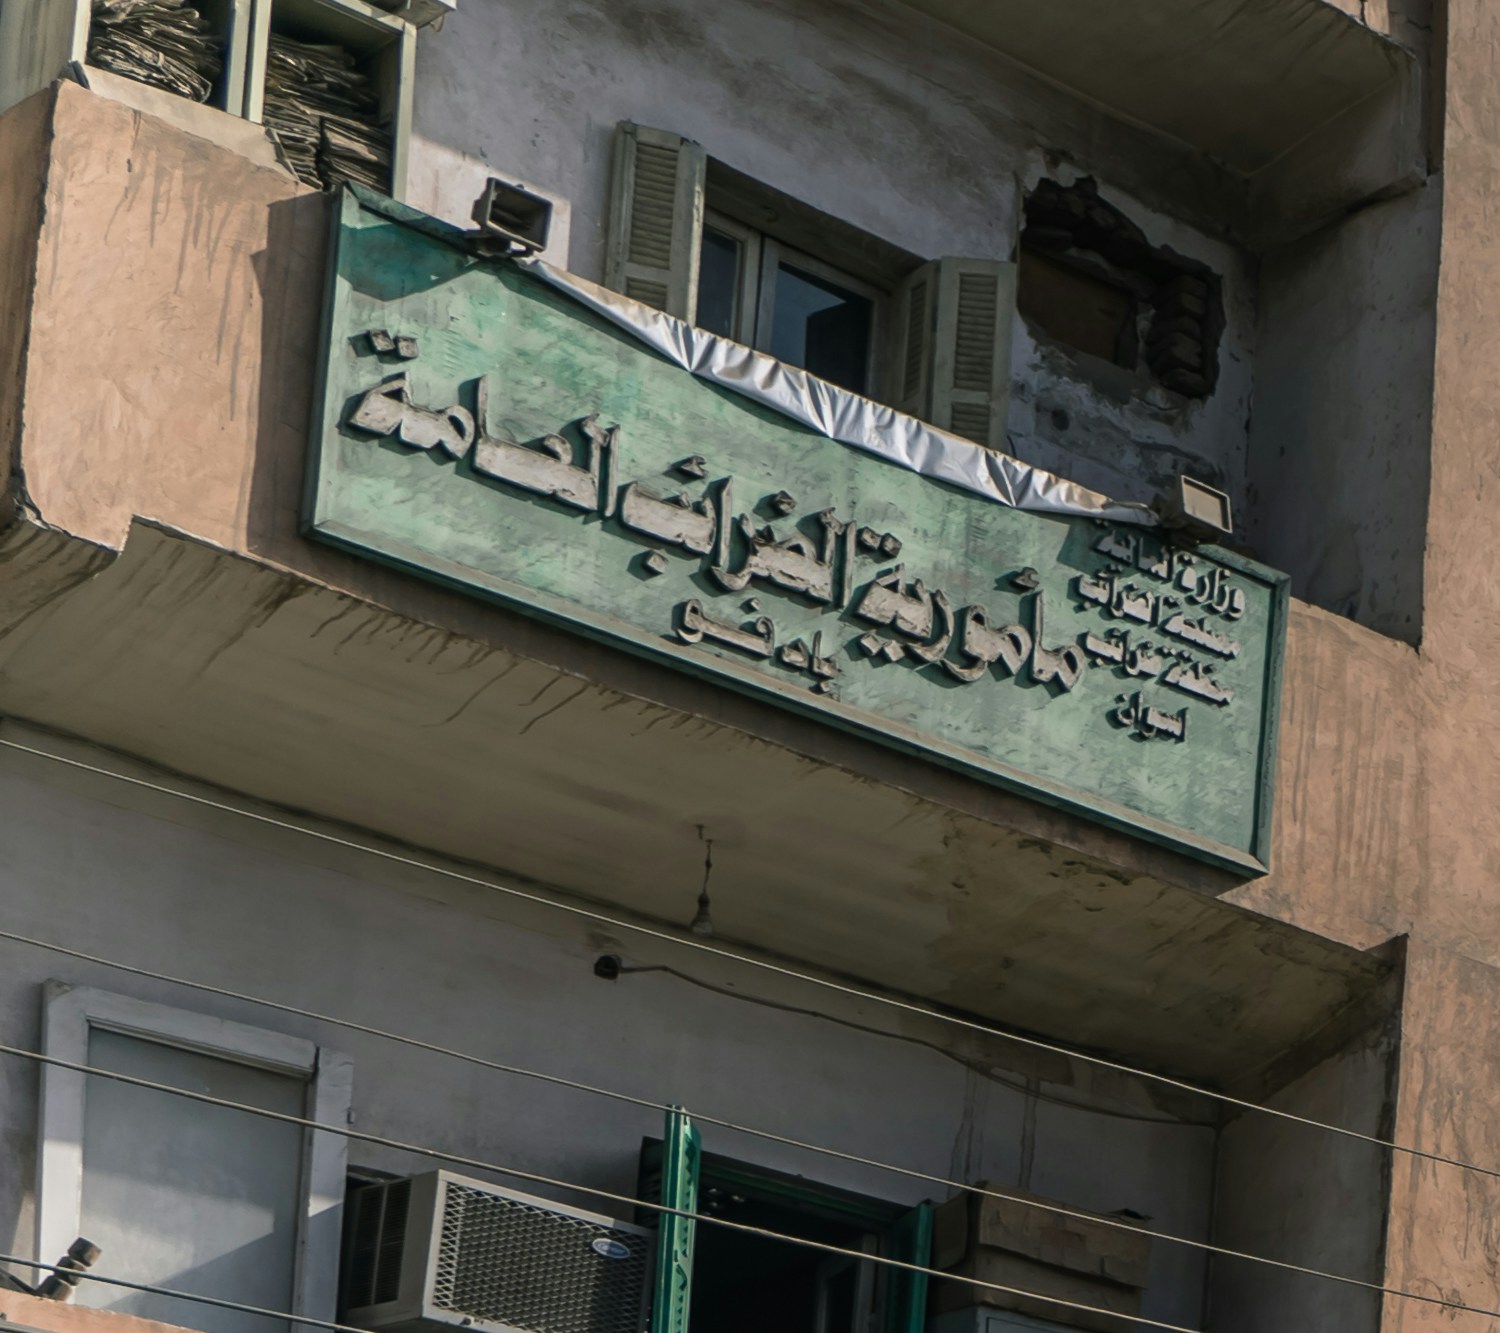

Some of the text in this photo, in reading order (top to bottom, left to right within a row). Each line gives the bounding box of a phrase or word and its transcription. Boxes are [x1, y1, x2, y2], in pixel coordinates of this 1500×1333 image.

[343, 327, 1085, 696] مأمورية الضرائب العامة
